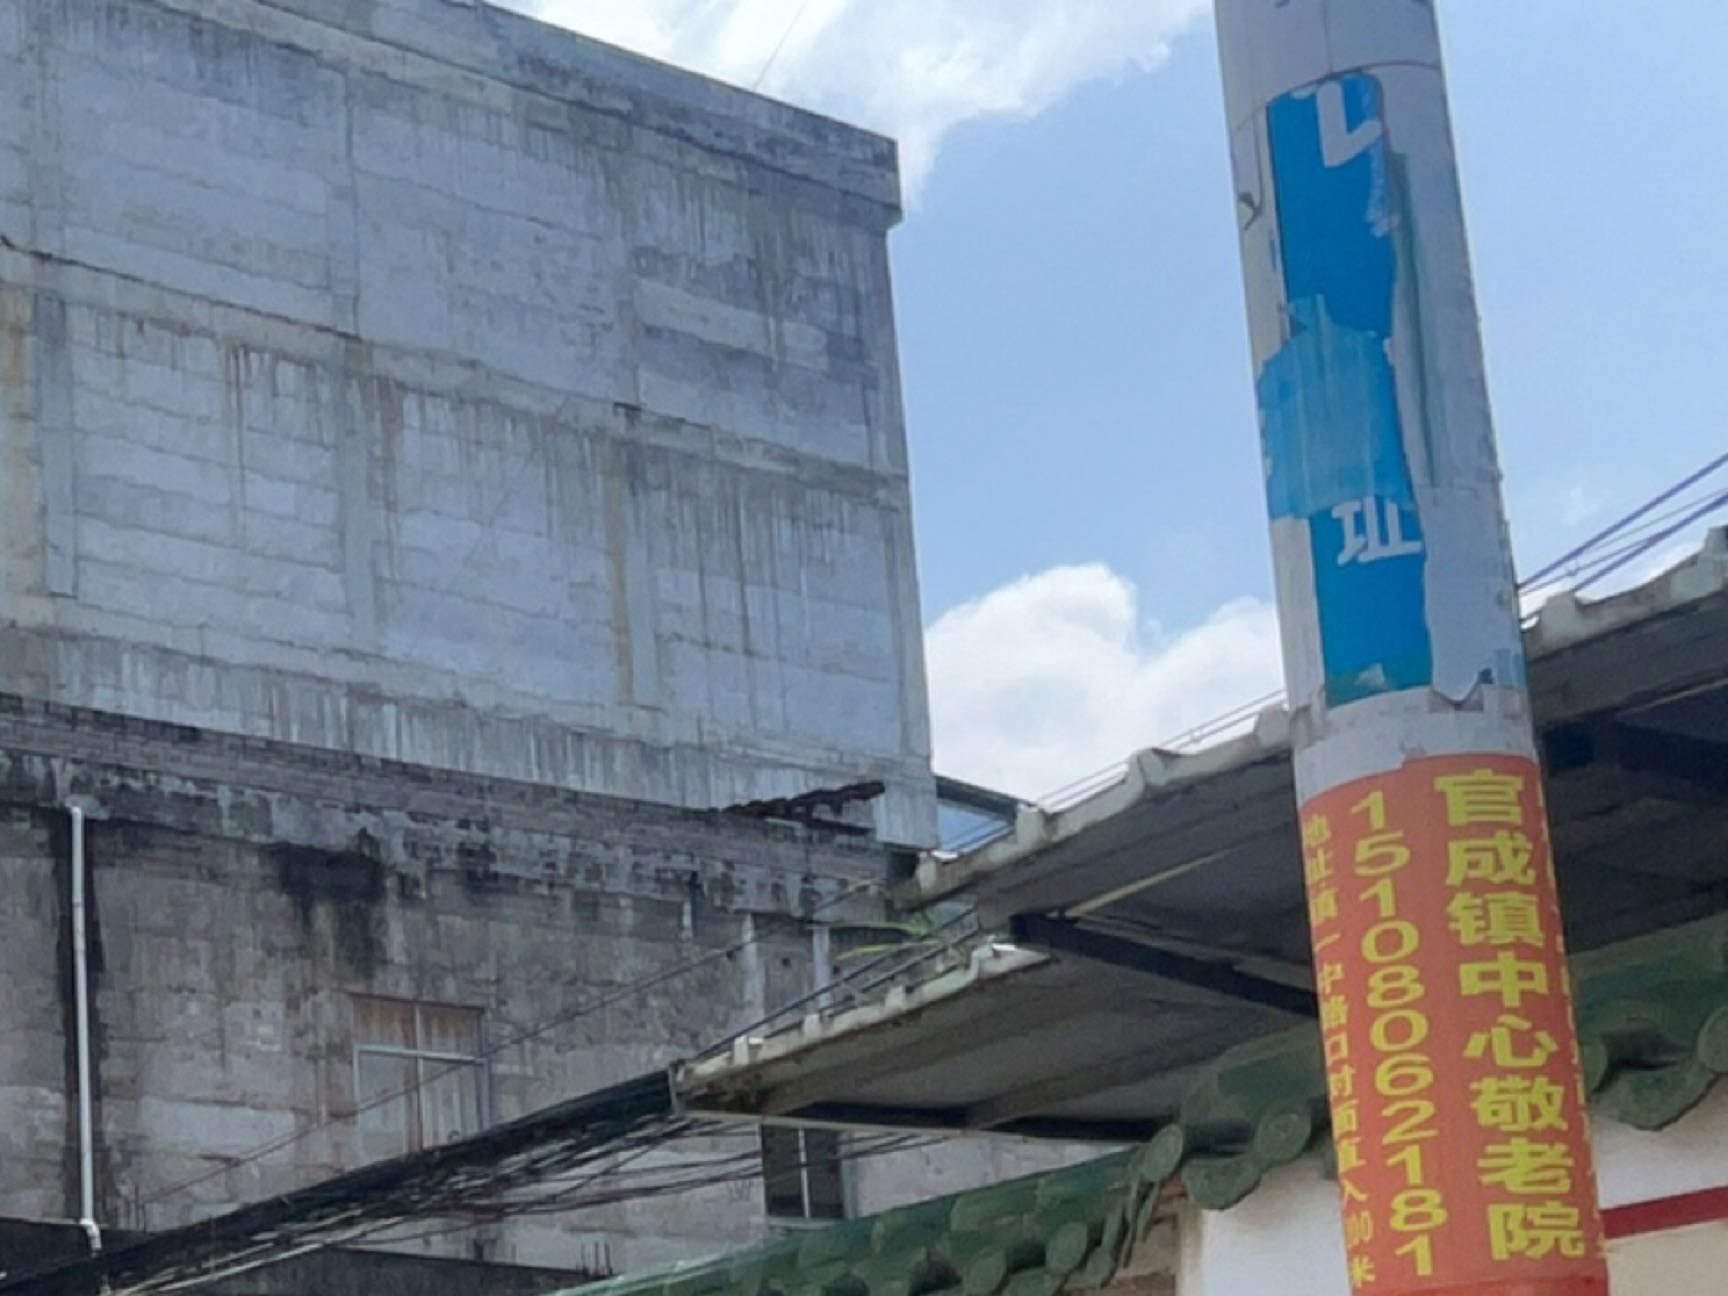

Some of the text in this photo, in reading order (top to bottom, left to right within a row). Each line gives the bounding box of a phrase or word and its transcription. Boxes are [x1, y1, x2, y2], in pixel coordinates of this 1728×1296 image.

[1351, 790, 1449, 1277] 15108062181
[1433, 768, 1586, 1261] 官成镇中心敬老院
